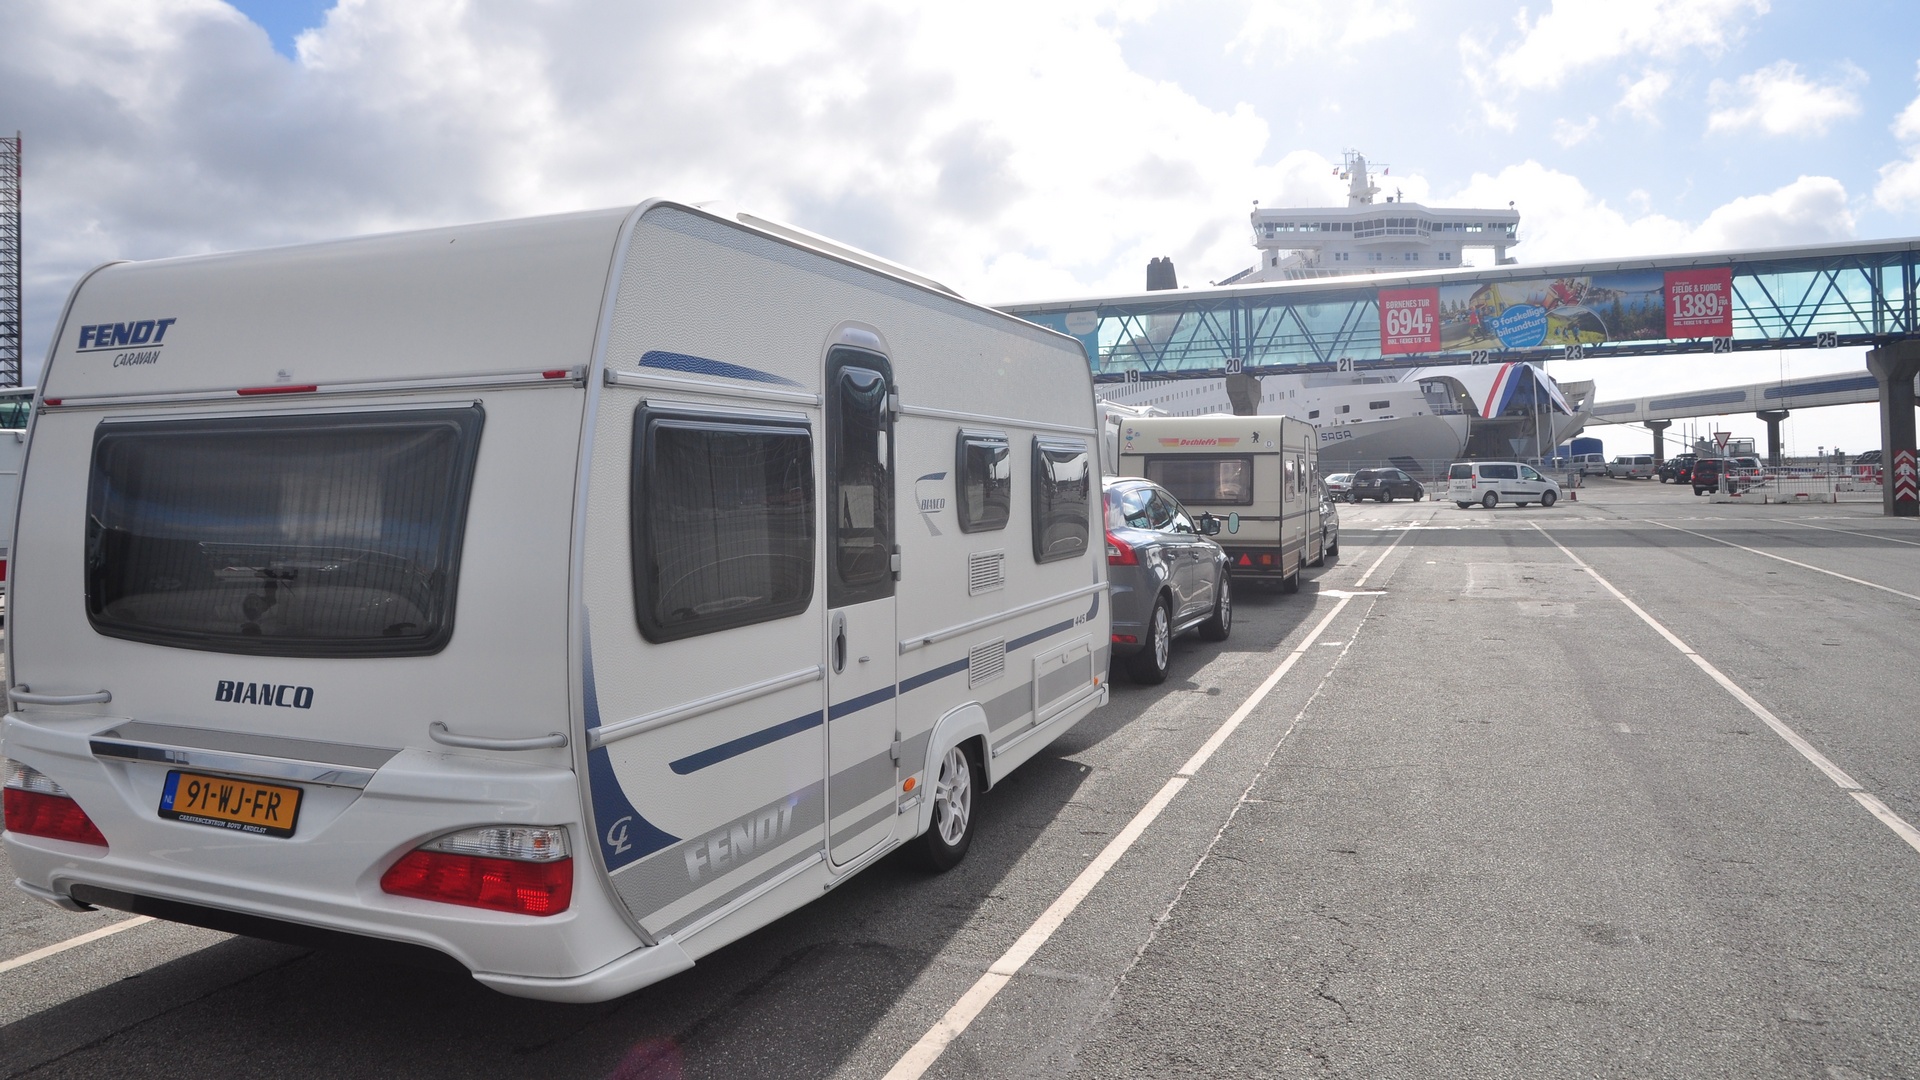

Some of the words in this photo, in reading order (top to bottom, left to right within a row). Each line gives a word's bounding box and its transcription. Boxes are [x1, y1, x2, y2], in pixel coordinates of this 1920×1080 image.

[1672, 284, 1693, 294] FJELDE
[1693, 284, 1699, 293] &
[1700, 283, 1722, 292] FJORDE
[1386, 299, 1417, 309] BØRNENES
[1417, 298, 1430, 307] TUR
[1492, 320, 1500, 328] 9
[1500, 306, 1546, 326] forskellige
[78, 317, 177, 349] FENDT
[1497, 317, 1547, 337] bilrundture
[1714, 337, 1731, 353] 24
[1818, 333, 1836, 348] 25
[113, 351, 160, 368] CARAVAN
[1472, 350, 1488, 365] 22
[1566, 345, 1582, 360] 23
[1226, 358, 1240, 373] 20
[1339, 358, 1352, 371] 21
[1125, 369, 1139, 382] 19
[1180, 438, 1218, 446] Dethleffs
[1321, 430, 1352, 441] SAGA
[921, 498, 946, 511] BIANCO
[1075, 613, 1086, 627] 445
[215, 680, 314, 709] BIANCO
[164, 795, 173, 804] NL
[187, 780, 282, 821] 91-WJ-FR
[178, 814, 226, 828] CARAVANCENTRUM
[242, 824, 267, 834] ANDELST
[683, 797, 798, 883] FENDT
